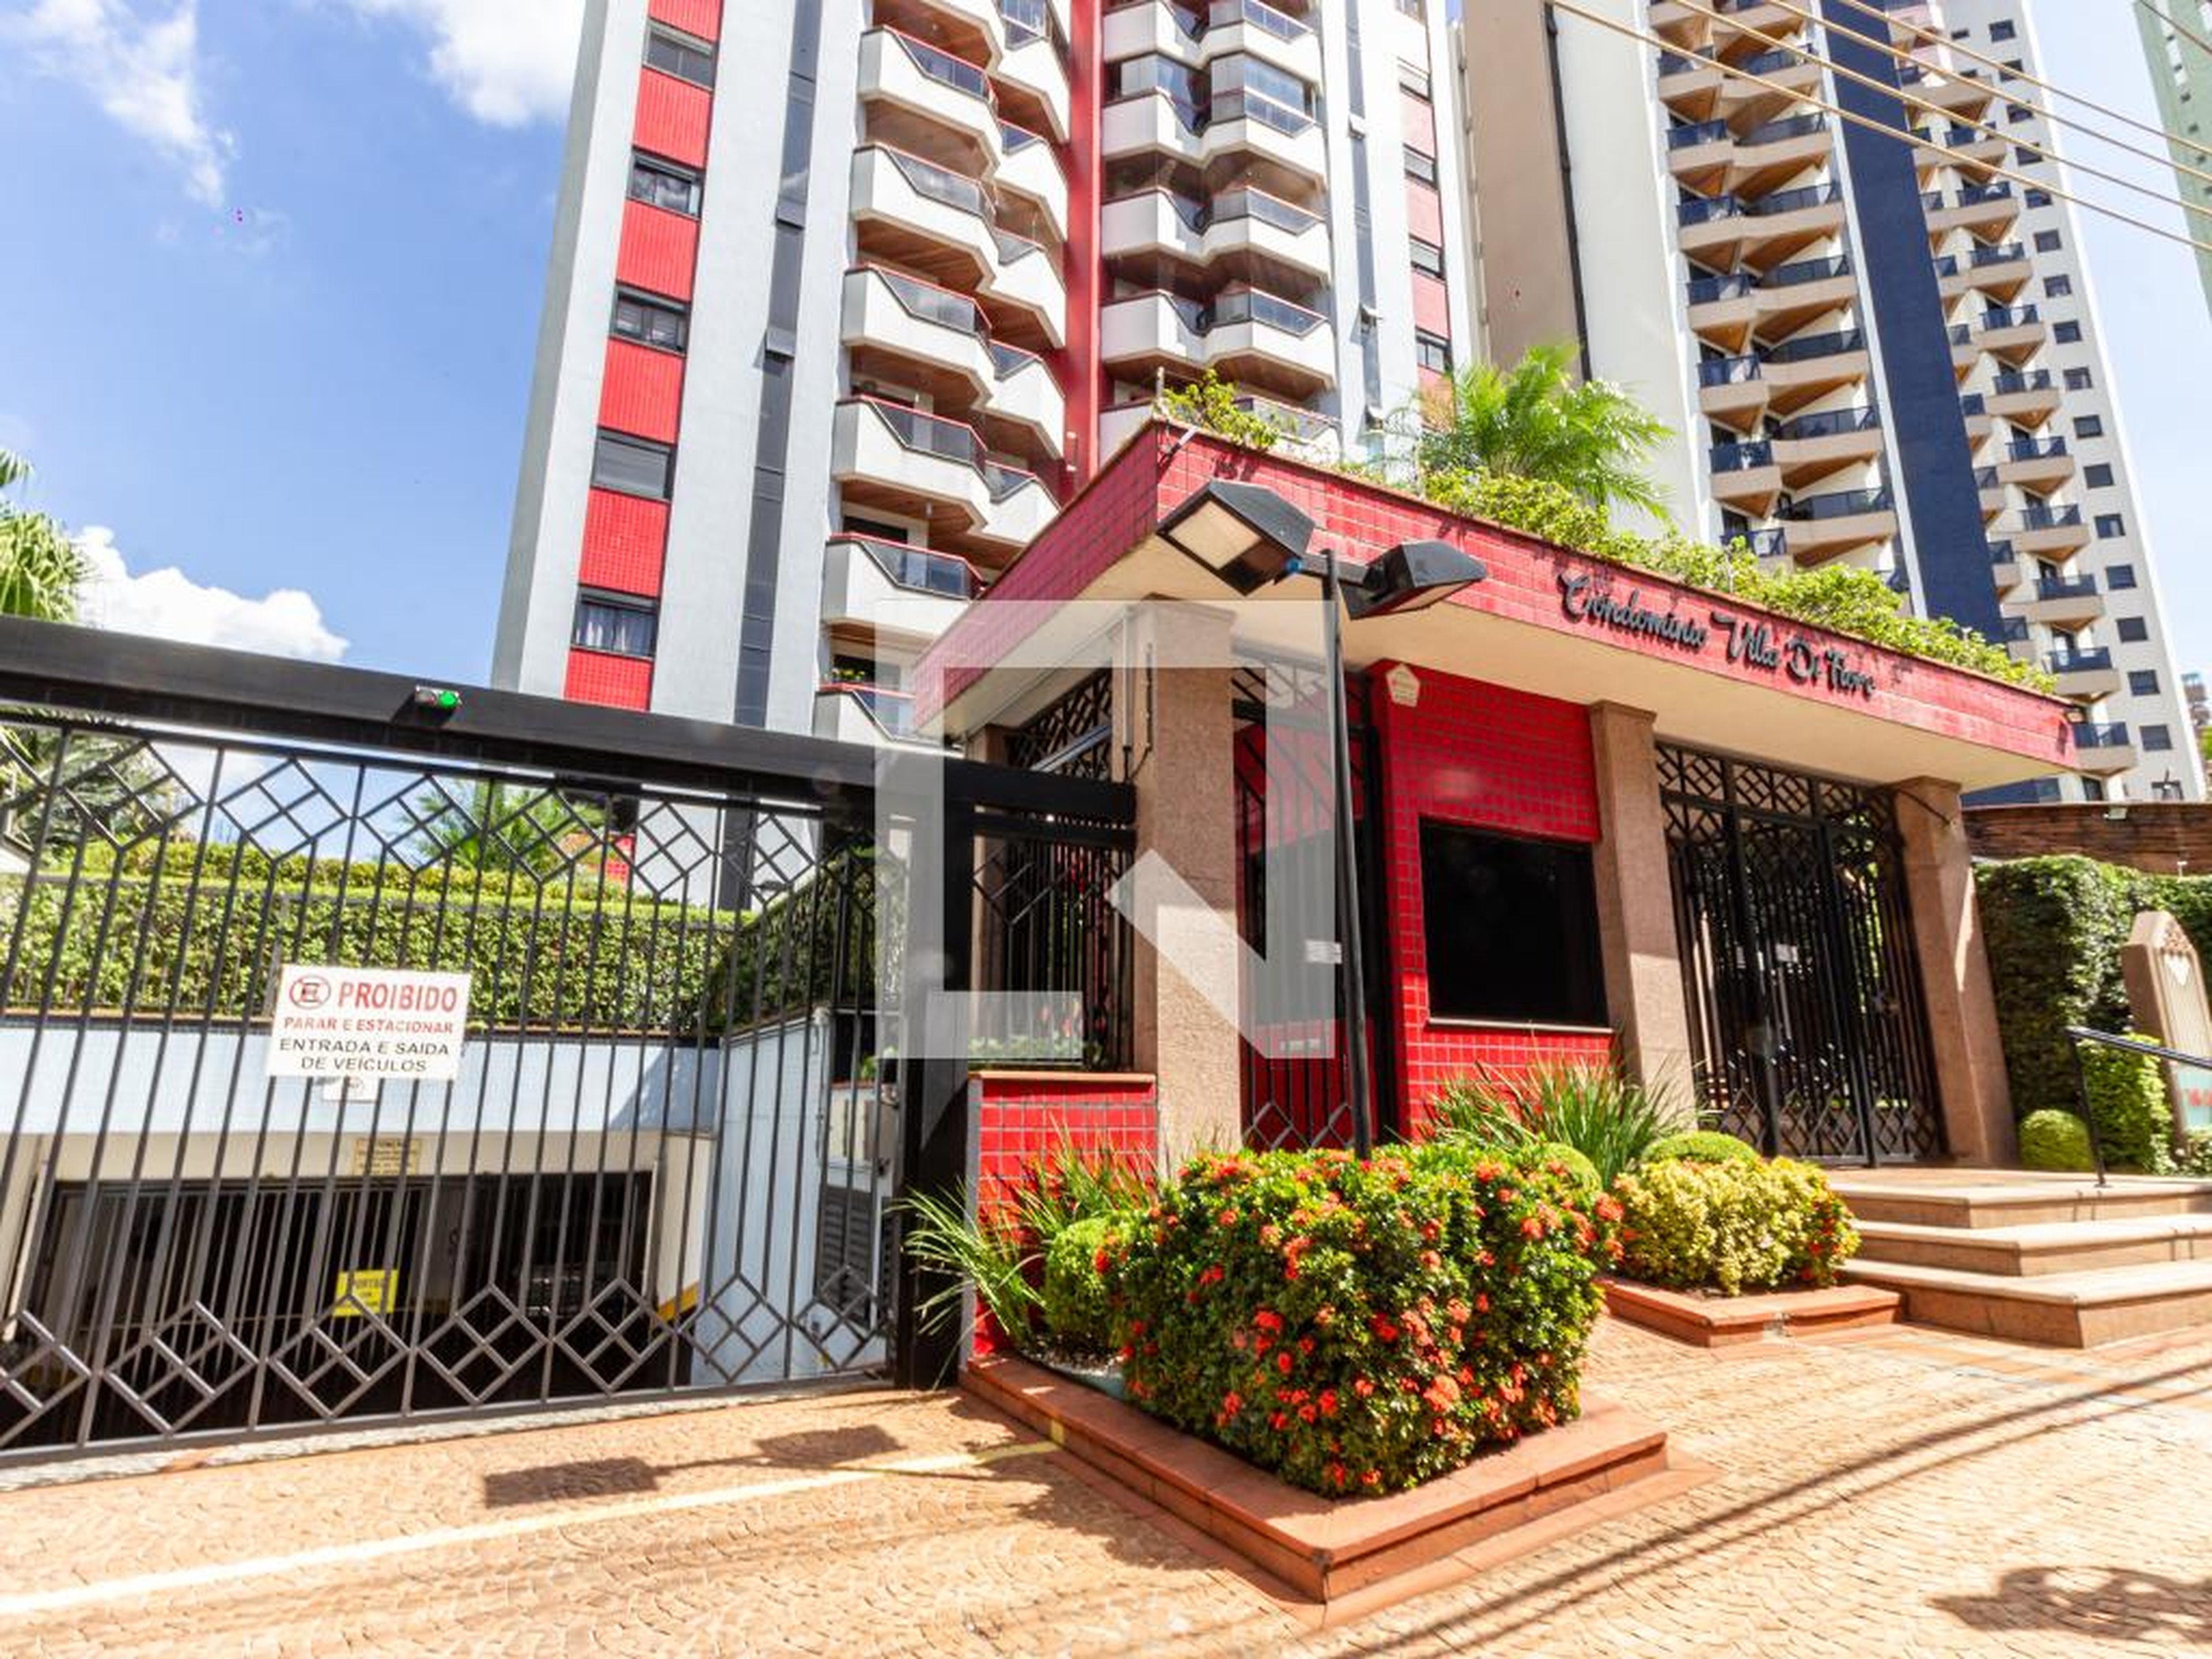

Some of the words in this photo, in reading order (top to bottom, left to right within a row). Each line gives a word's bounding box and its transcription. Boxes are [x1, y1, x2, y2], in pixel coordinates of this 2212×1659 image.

[338, 982, 458, 1012] PROIBIDO
[283, 1017, 338, 1031] PARAR
[343, 1019, 352, 1031] E
[356, 1019, 454, 1034] ESTACIONAR
[280, 1038, 370, 1052] ENTRADA
[378, 1041, 390, 1055] E
[301, 1056, 326, 1069] DE
